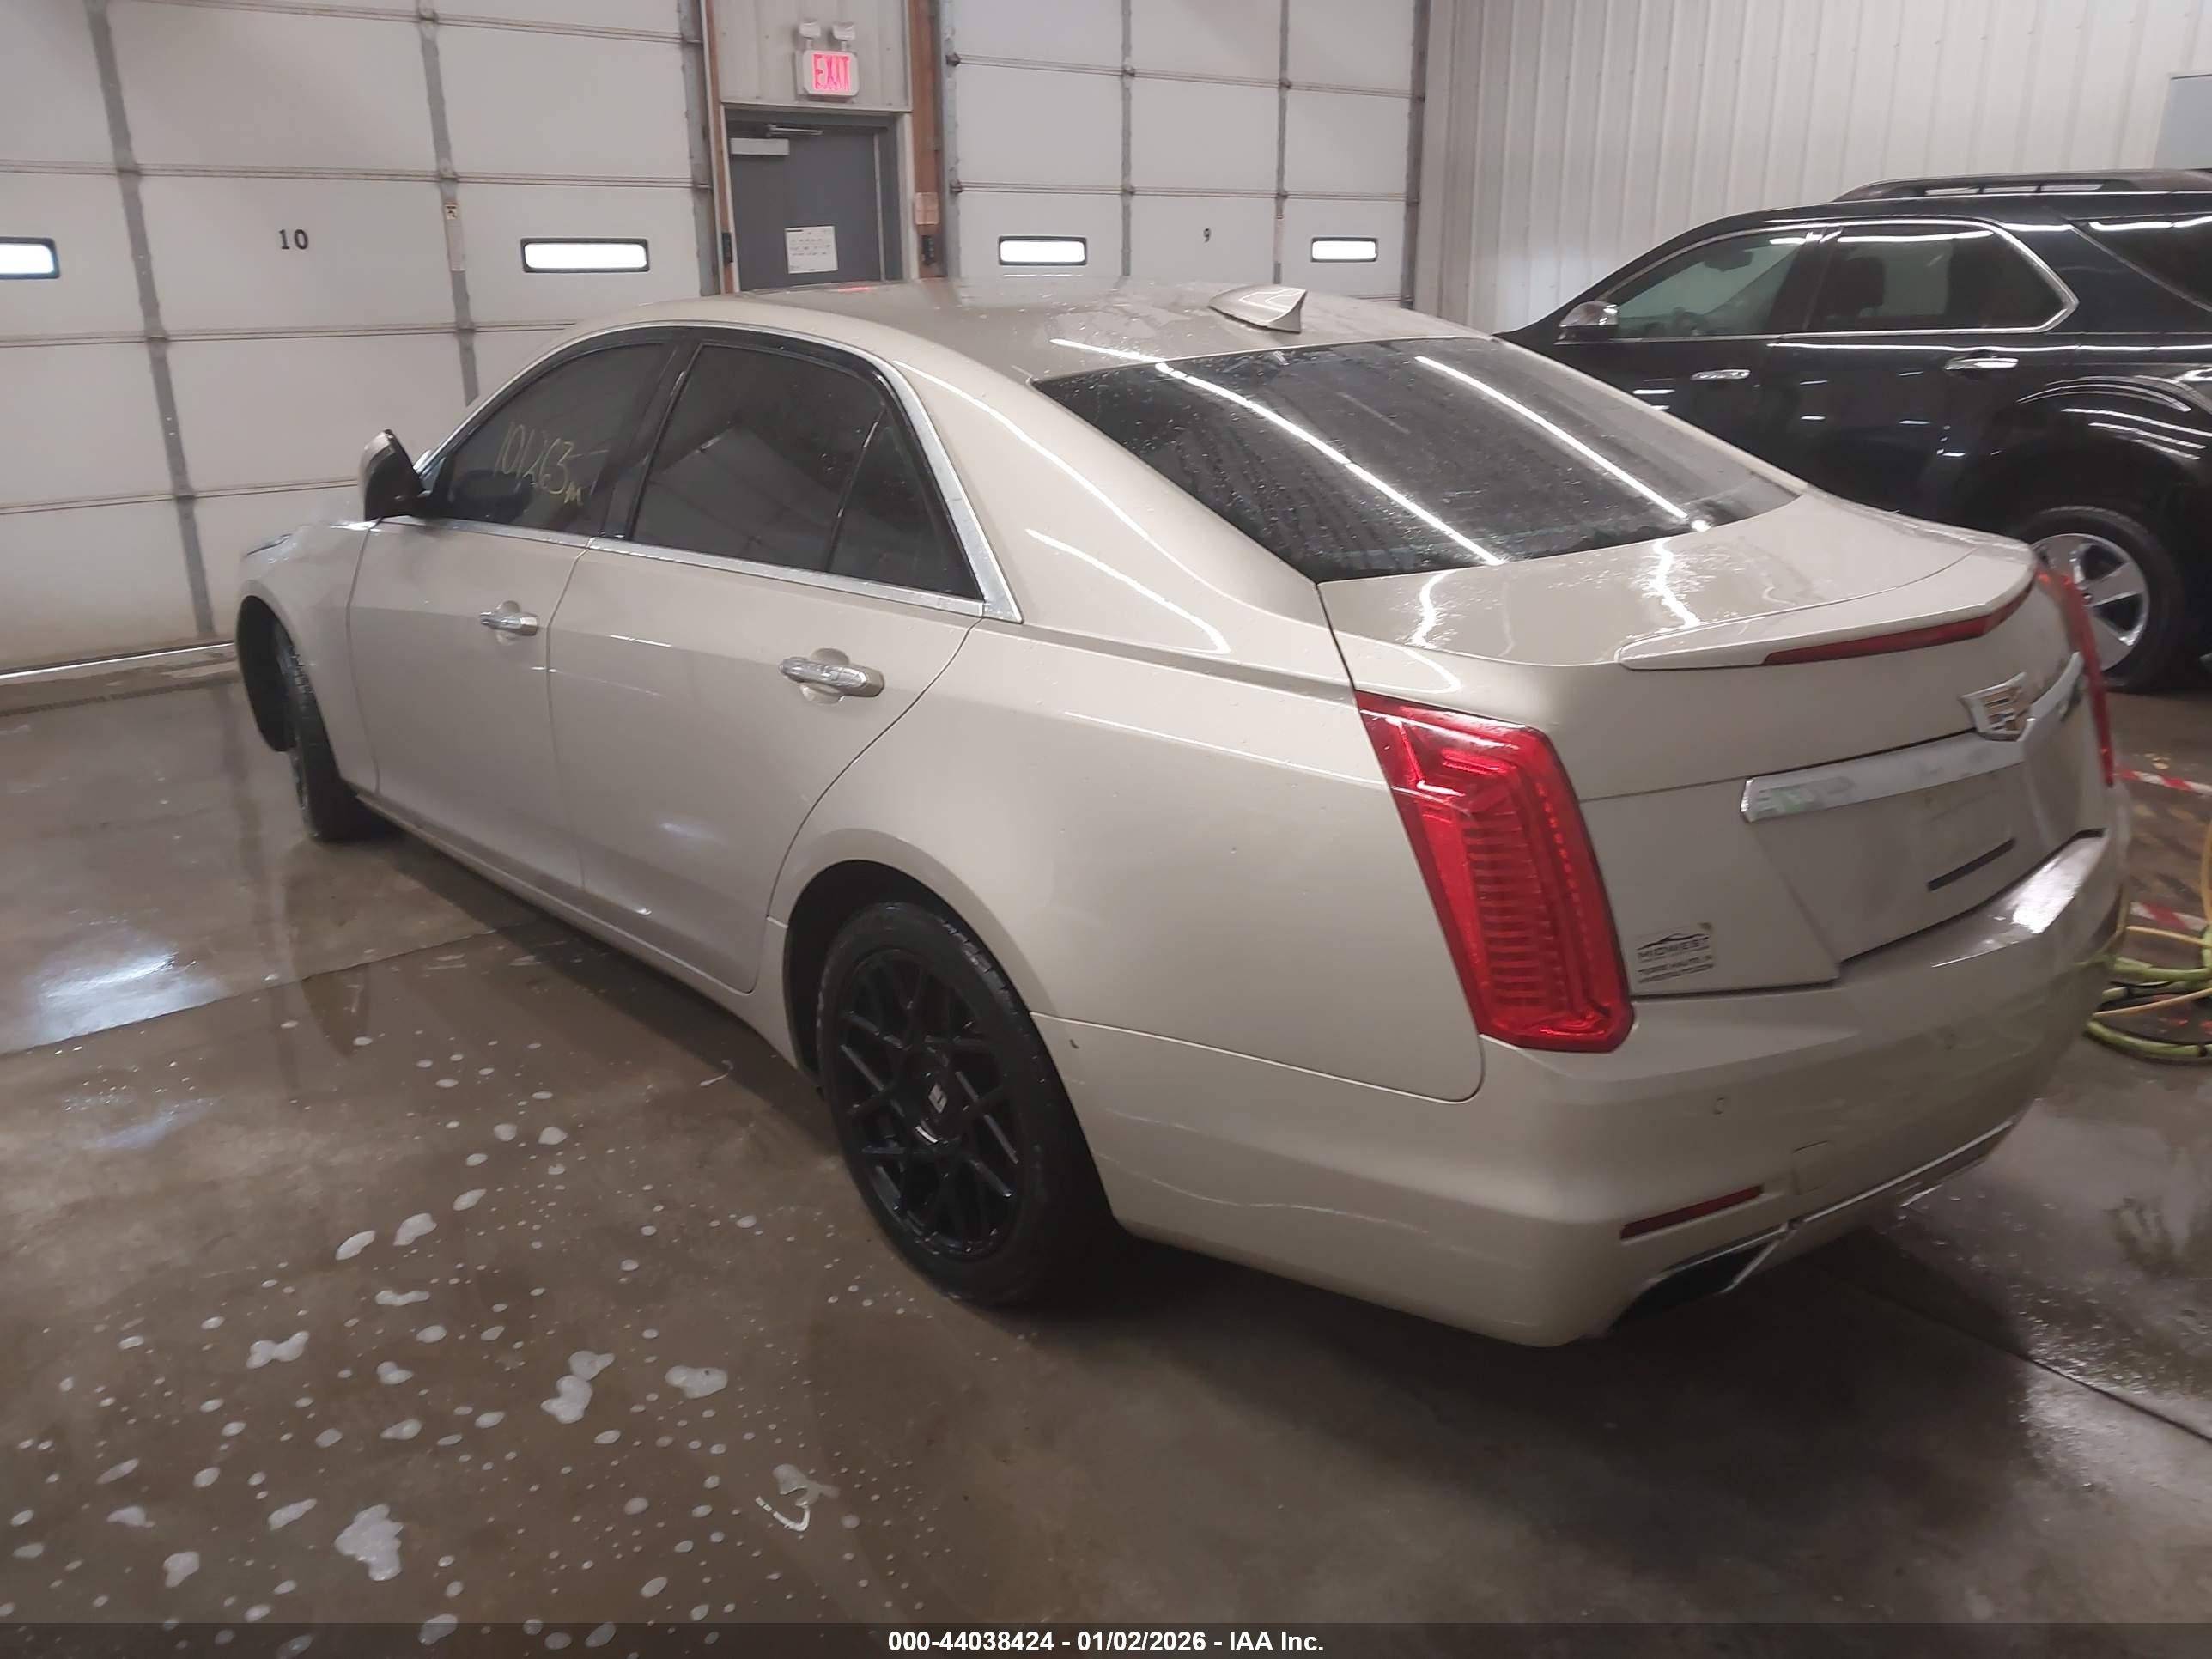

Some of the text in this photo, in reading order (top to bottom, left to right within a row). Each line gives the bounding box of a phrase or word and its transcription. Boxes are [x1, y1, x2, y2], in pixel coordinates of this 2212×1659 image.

[813, 53, 849, 90] EXIT
[279, 228, 309, 250] 10
[1202, 228, 1212, 243] 9
